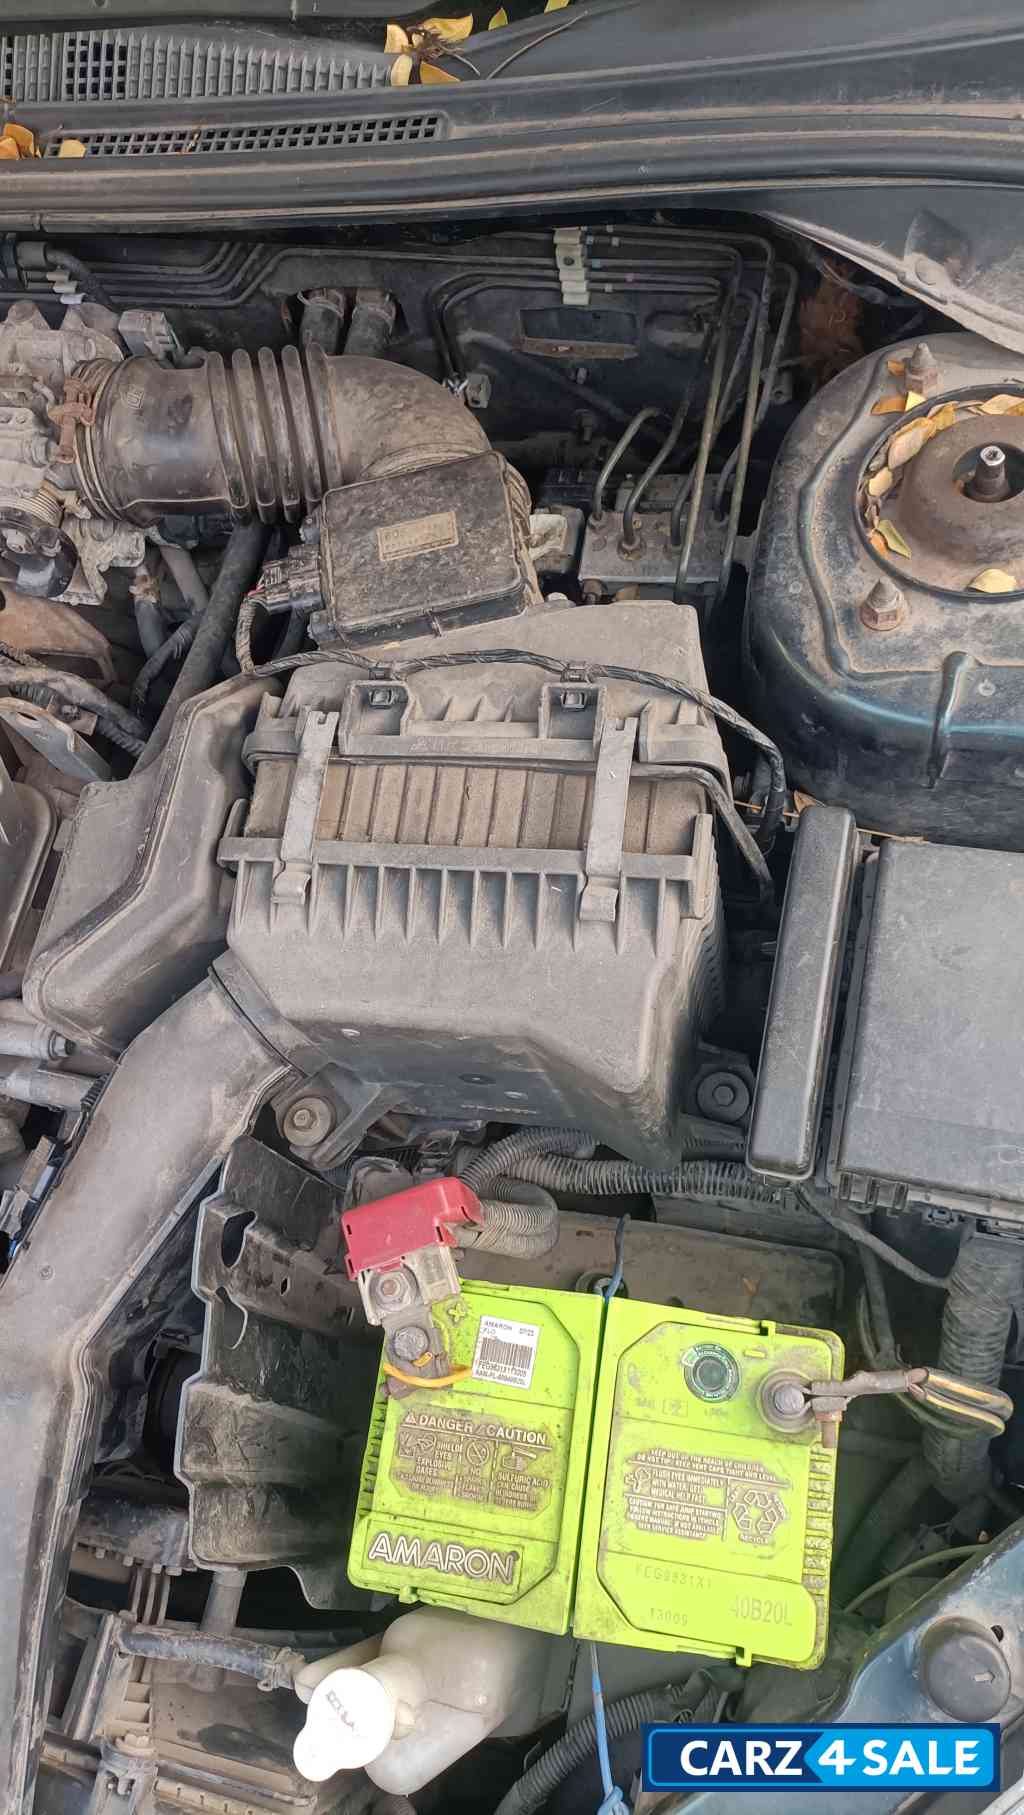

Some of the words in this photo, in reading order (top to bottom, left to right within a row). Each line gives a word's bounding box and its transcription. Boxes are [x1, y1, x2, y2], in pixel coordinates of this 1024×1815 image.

[418, 1414, 473, 1433] DANGER
[485, 1424, 546, 1445] CAUTION
[369, 1532, 513, 1584] AMARON
